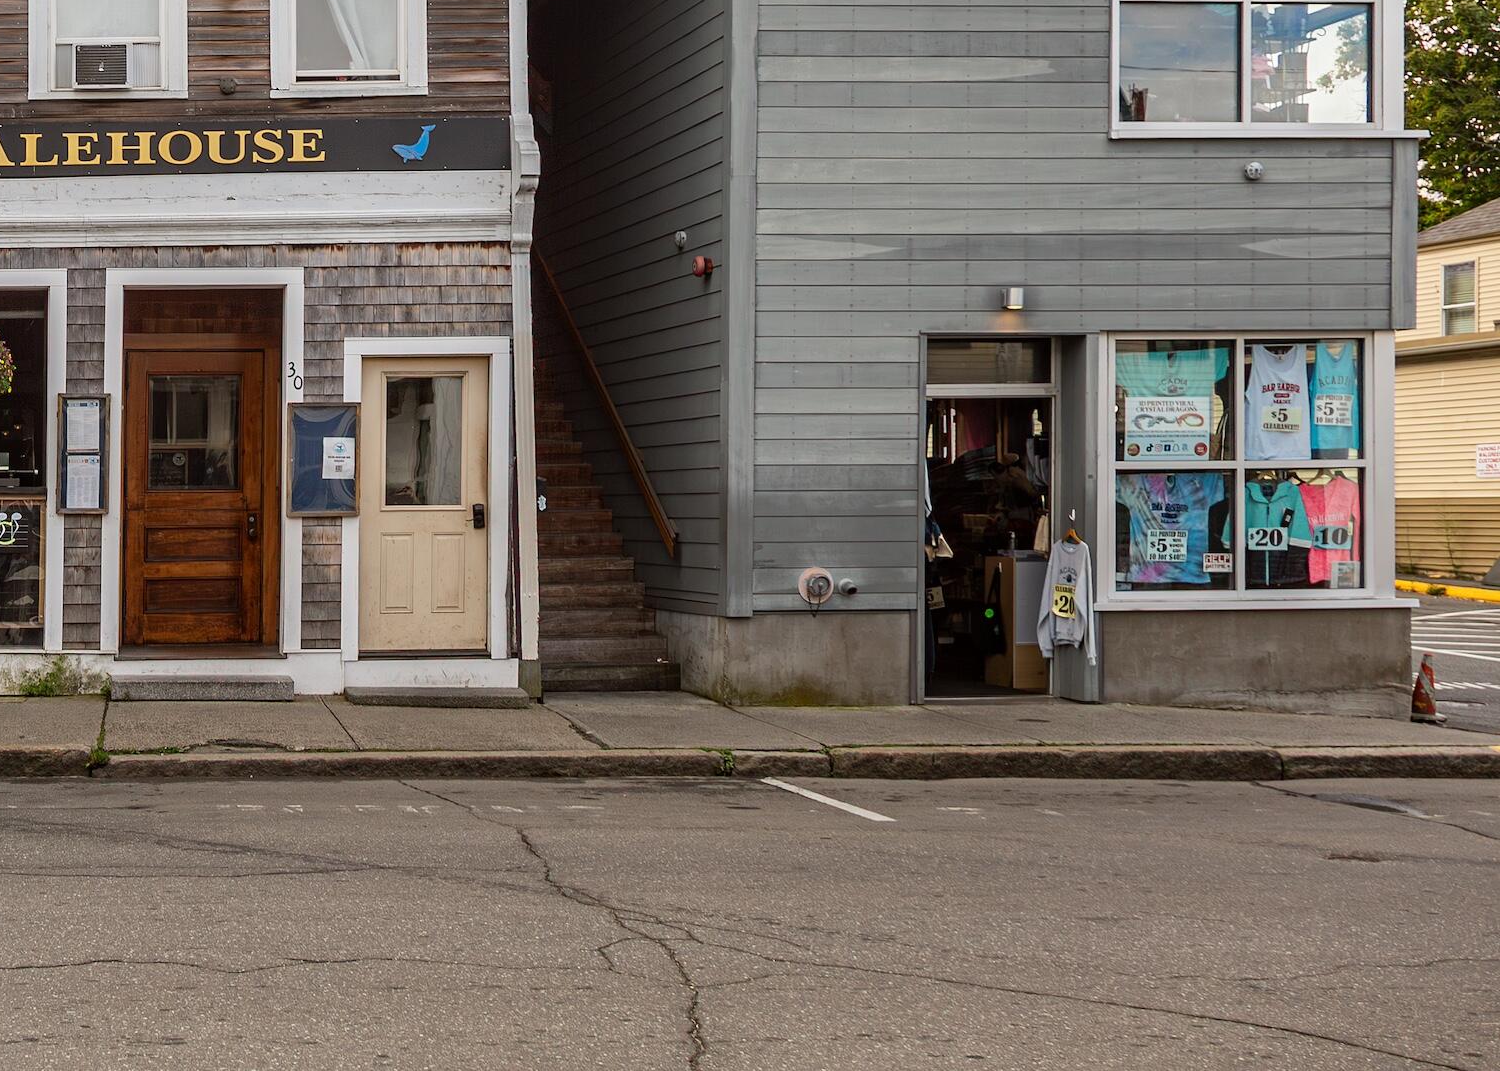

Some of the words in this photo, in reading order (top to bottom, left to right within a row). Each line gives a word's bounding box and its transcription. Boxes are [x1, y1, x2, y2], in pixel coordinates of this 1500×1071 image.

[1271, 408, 1288, 422] $5
[1317, 402, 1334, 416] $5
[1250, 528, 1283, 547] $20
[1314, 528, 1349, 546] $10
[1150, 538, 1168, 553] $5
[1055, 595, 1076, 615] $20
